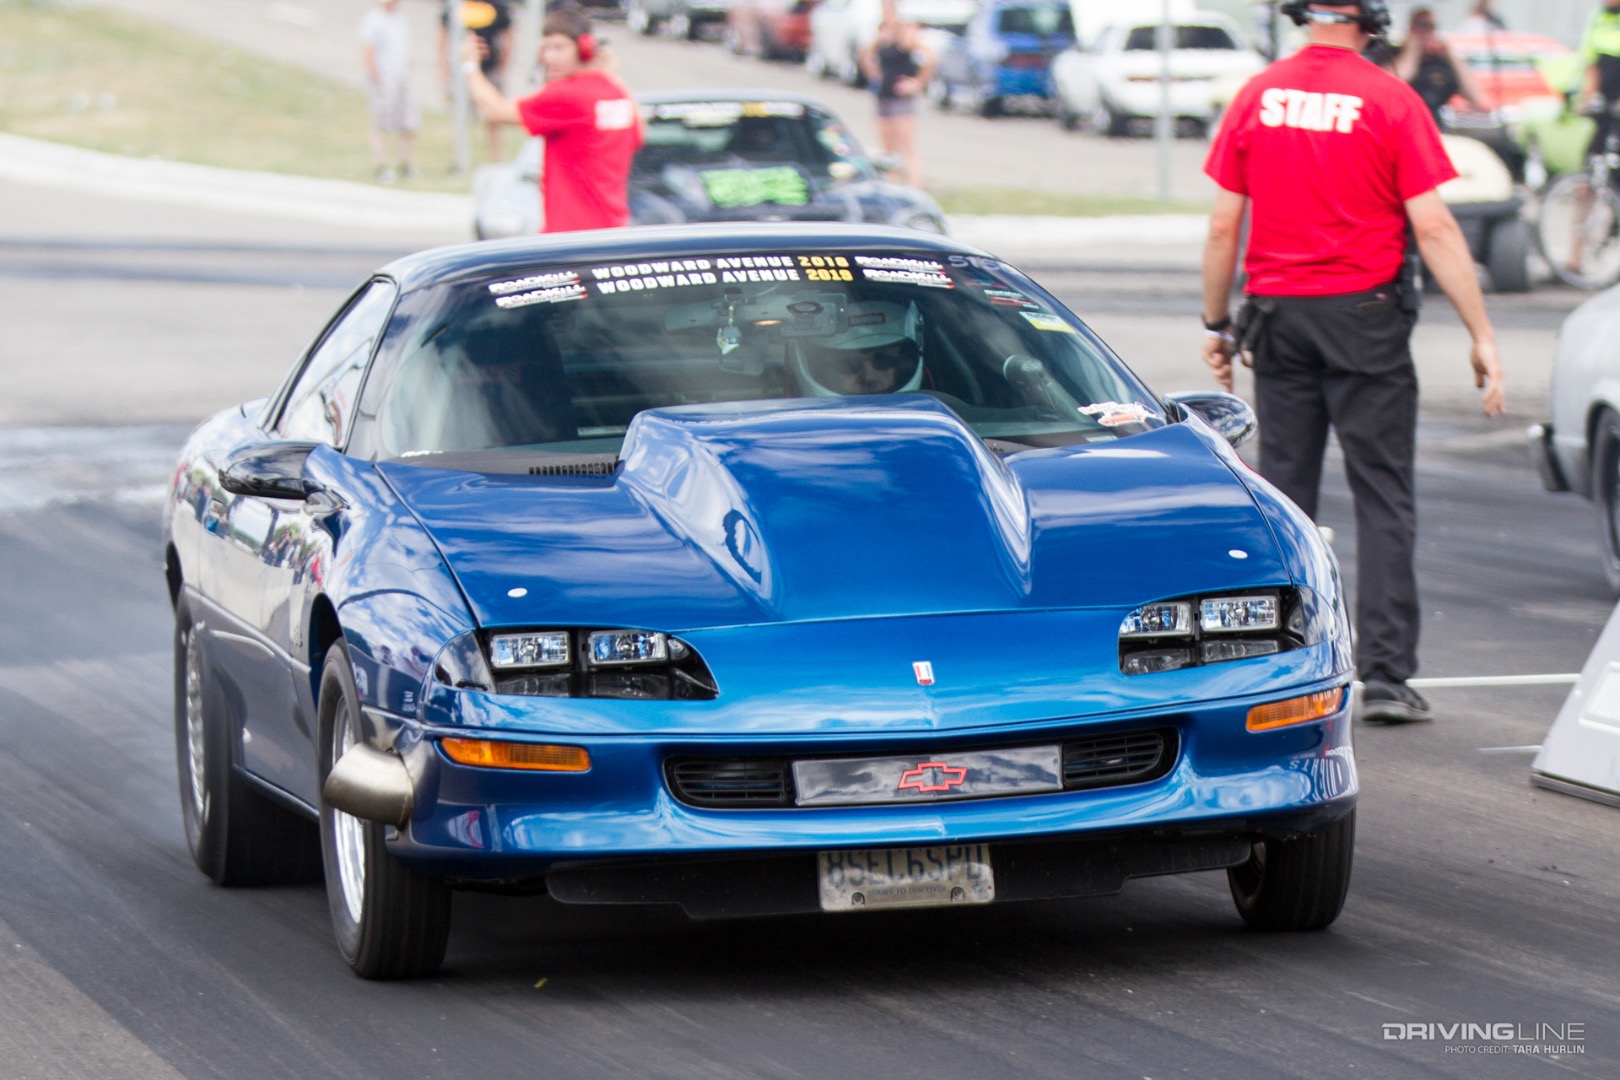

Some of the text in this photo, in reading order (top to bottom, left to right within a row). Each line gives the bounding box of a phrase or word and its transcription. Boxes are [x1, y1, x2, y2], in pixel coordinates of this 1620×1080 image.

[1260, 87, 1363, 133] STAFF
[592, 256, 849, 279] WOODWARD AVENUE 2018
[597, 269, 853, 294] WOODWARD AVENUE 2019
